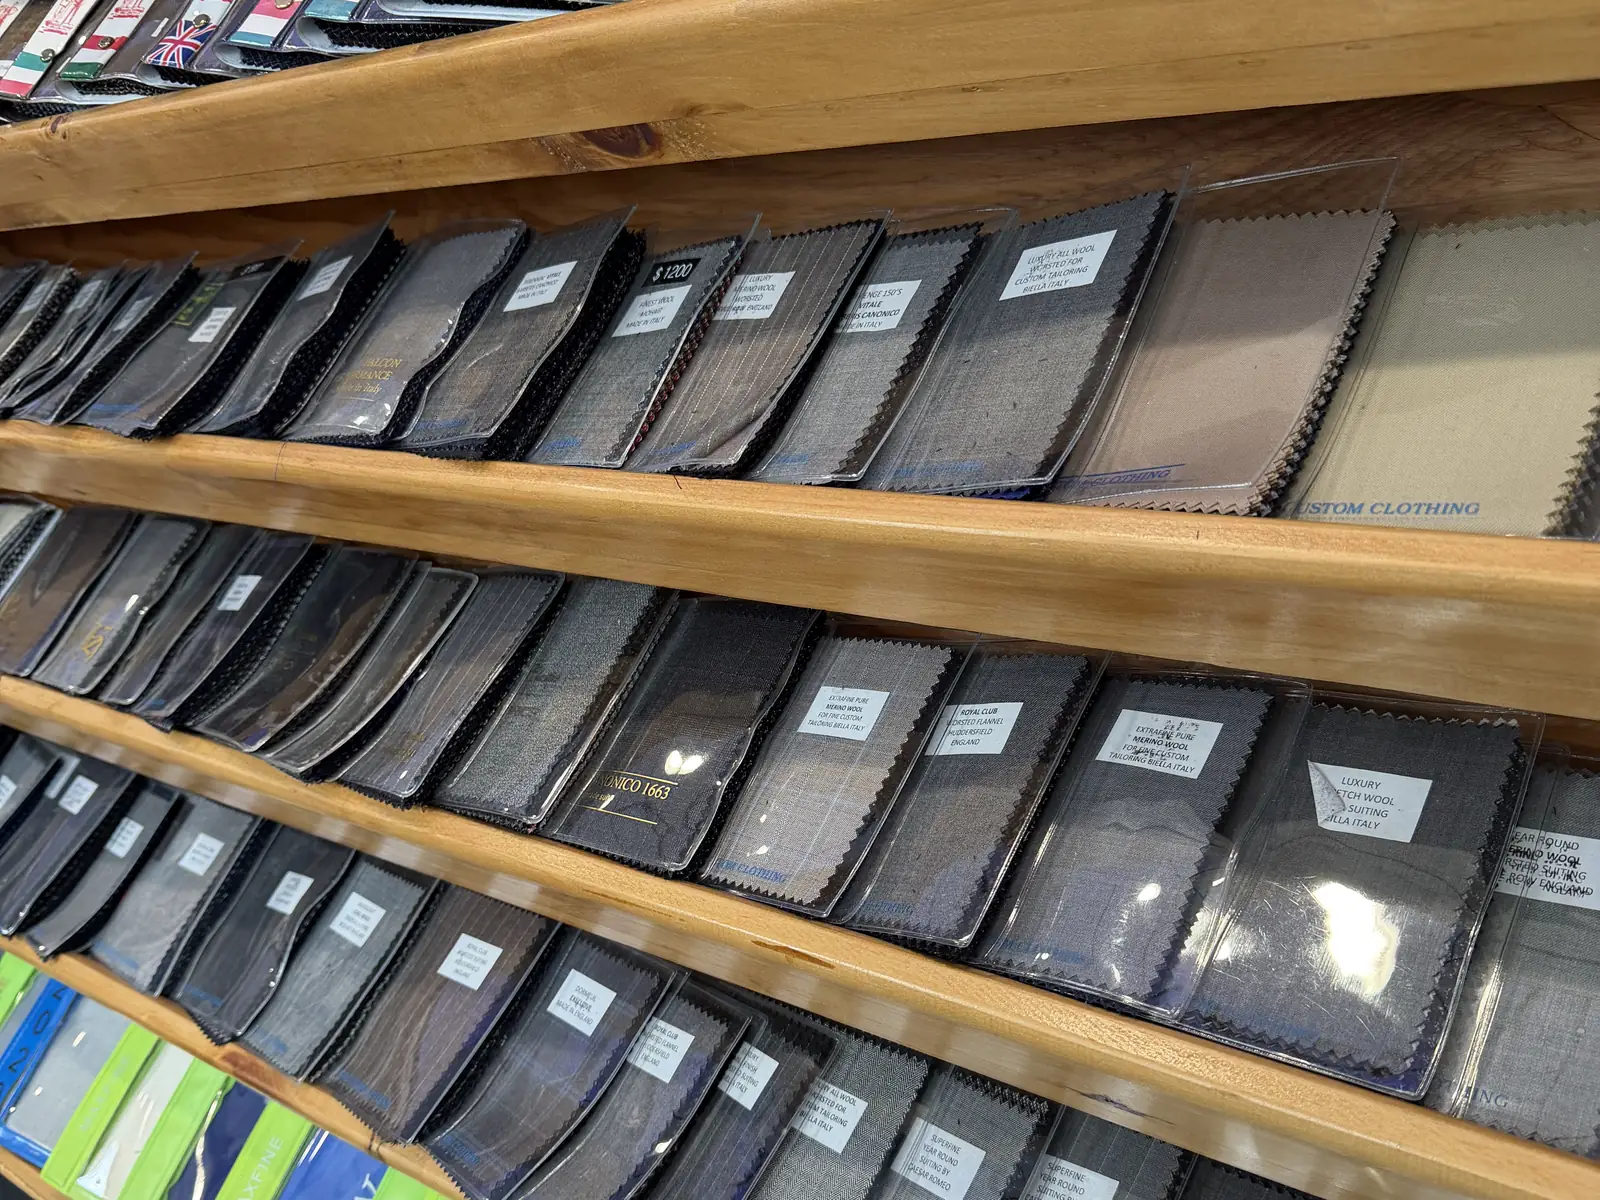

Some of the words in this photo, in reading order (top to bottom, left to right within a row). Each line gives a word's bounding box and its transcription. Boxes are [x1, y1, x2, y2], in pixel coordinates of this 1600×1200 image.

[1027, 252, 1057, 265] LUXURY
[1056, 250, 1070, 258] ALL
[1072, 245, 1096, 255] WOOL
[652, 266, 663, 282] $
[664, 263, 693, 279] 1200
[1029, 261, 1067, 273] WORSTED
[1067, 257, 1084, 266] FOR
[1014, 273, 1046, 286] CUSTOM
[1048, 265, 1089, 280] TAILORING
[1022, 283, 1047, 294] BIELLA
[1047, 279, 1070, 288] ITALY
[861, 309, 901, 319] CANONICO
[1370, 502, 1481, 516] CLOTHING
[825, 703, 847, 711] MERINO
[960, 708, 980, 716] ROYAL
[981, 707, 998, 715] CLUB
[840, 714, 863, 722] CUSTOM
[1135, 725, 1174, 739] EXTRAFINE
[1175, 732, 1196, 741] PURE
[950, 738, 980, 747] ENGLAND
[1132, 735, 1163, 746] MERINO
[1165, 740, 1188, 751] WOOL
[1122, 743, 1137, 752] FOR
[1155, 749, 1190, 762] CUSTOM
[1108, 752, 1147, 764] TAILORING
[1147, 758, 1172, 769] BIELLA
[1172, 763, 1195, 774] ITALY
[642, 782, 671, 800] 1663
[1341, 776, 1381, 790] LUXURY
[1364, 793, 1395, 806] WOOL
[1348, 804, 1389, 818] SUITING
[1351, 818, 1381, 830] ITALY
[1514, 831, 1535, 842] EAR
[1508, 844, 1543, 859] ERINO
[1547, 851, 1582, 866] WOOL
[1505, 858, 1539, 871] RSTED
[1542, 865, 1587, 881] SUITING
[1540, 879, 1594, 896] ENGLAND
[839, 1093, 857, 1107] WOOL
[834, 1104, 847, 1114] FOR
[817, 1119, 834, 1132] ITALY
[819, 1107, 849, 1128] TAILORING
[930, 1133, 962, 1155] SUPERFINE
[922, 1143, 938, 1157] YEAR
[936, 1150, 959, 1167] ROUND
[919, 1155, 943, 1173] SUITING
[941, 1166, 951, 1177] BY
[1047, 1162, 1087, 1183] SUPERFINE
[928, 1173, 952, 1192] ROMEO
[1039, 1172, 1057, 1185] YEAR
[1057, 1179, 1085, 1196] ROUND
